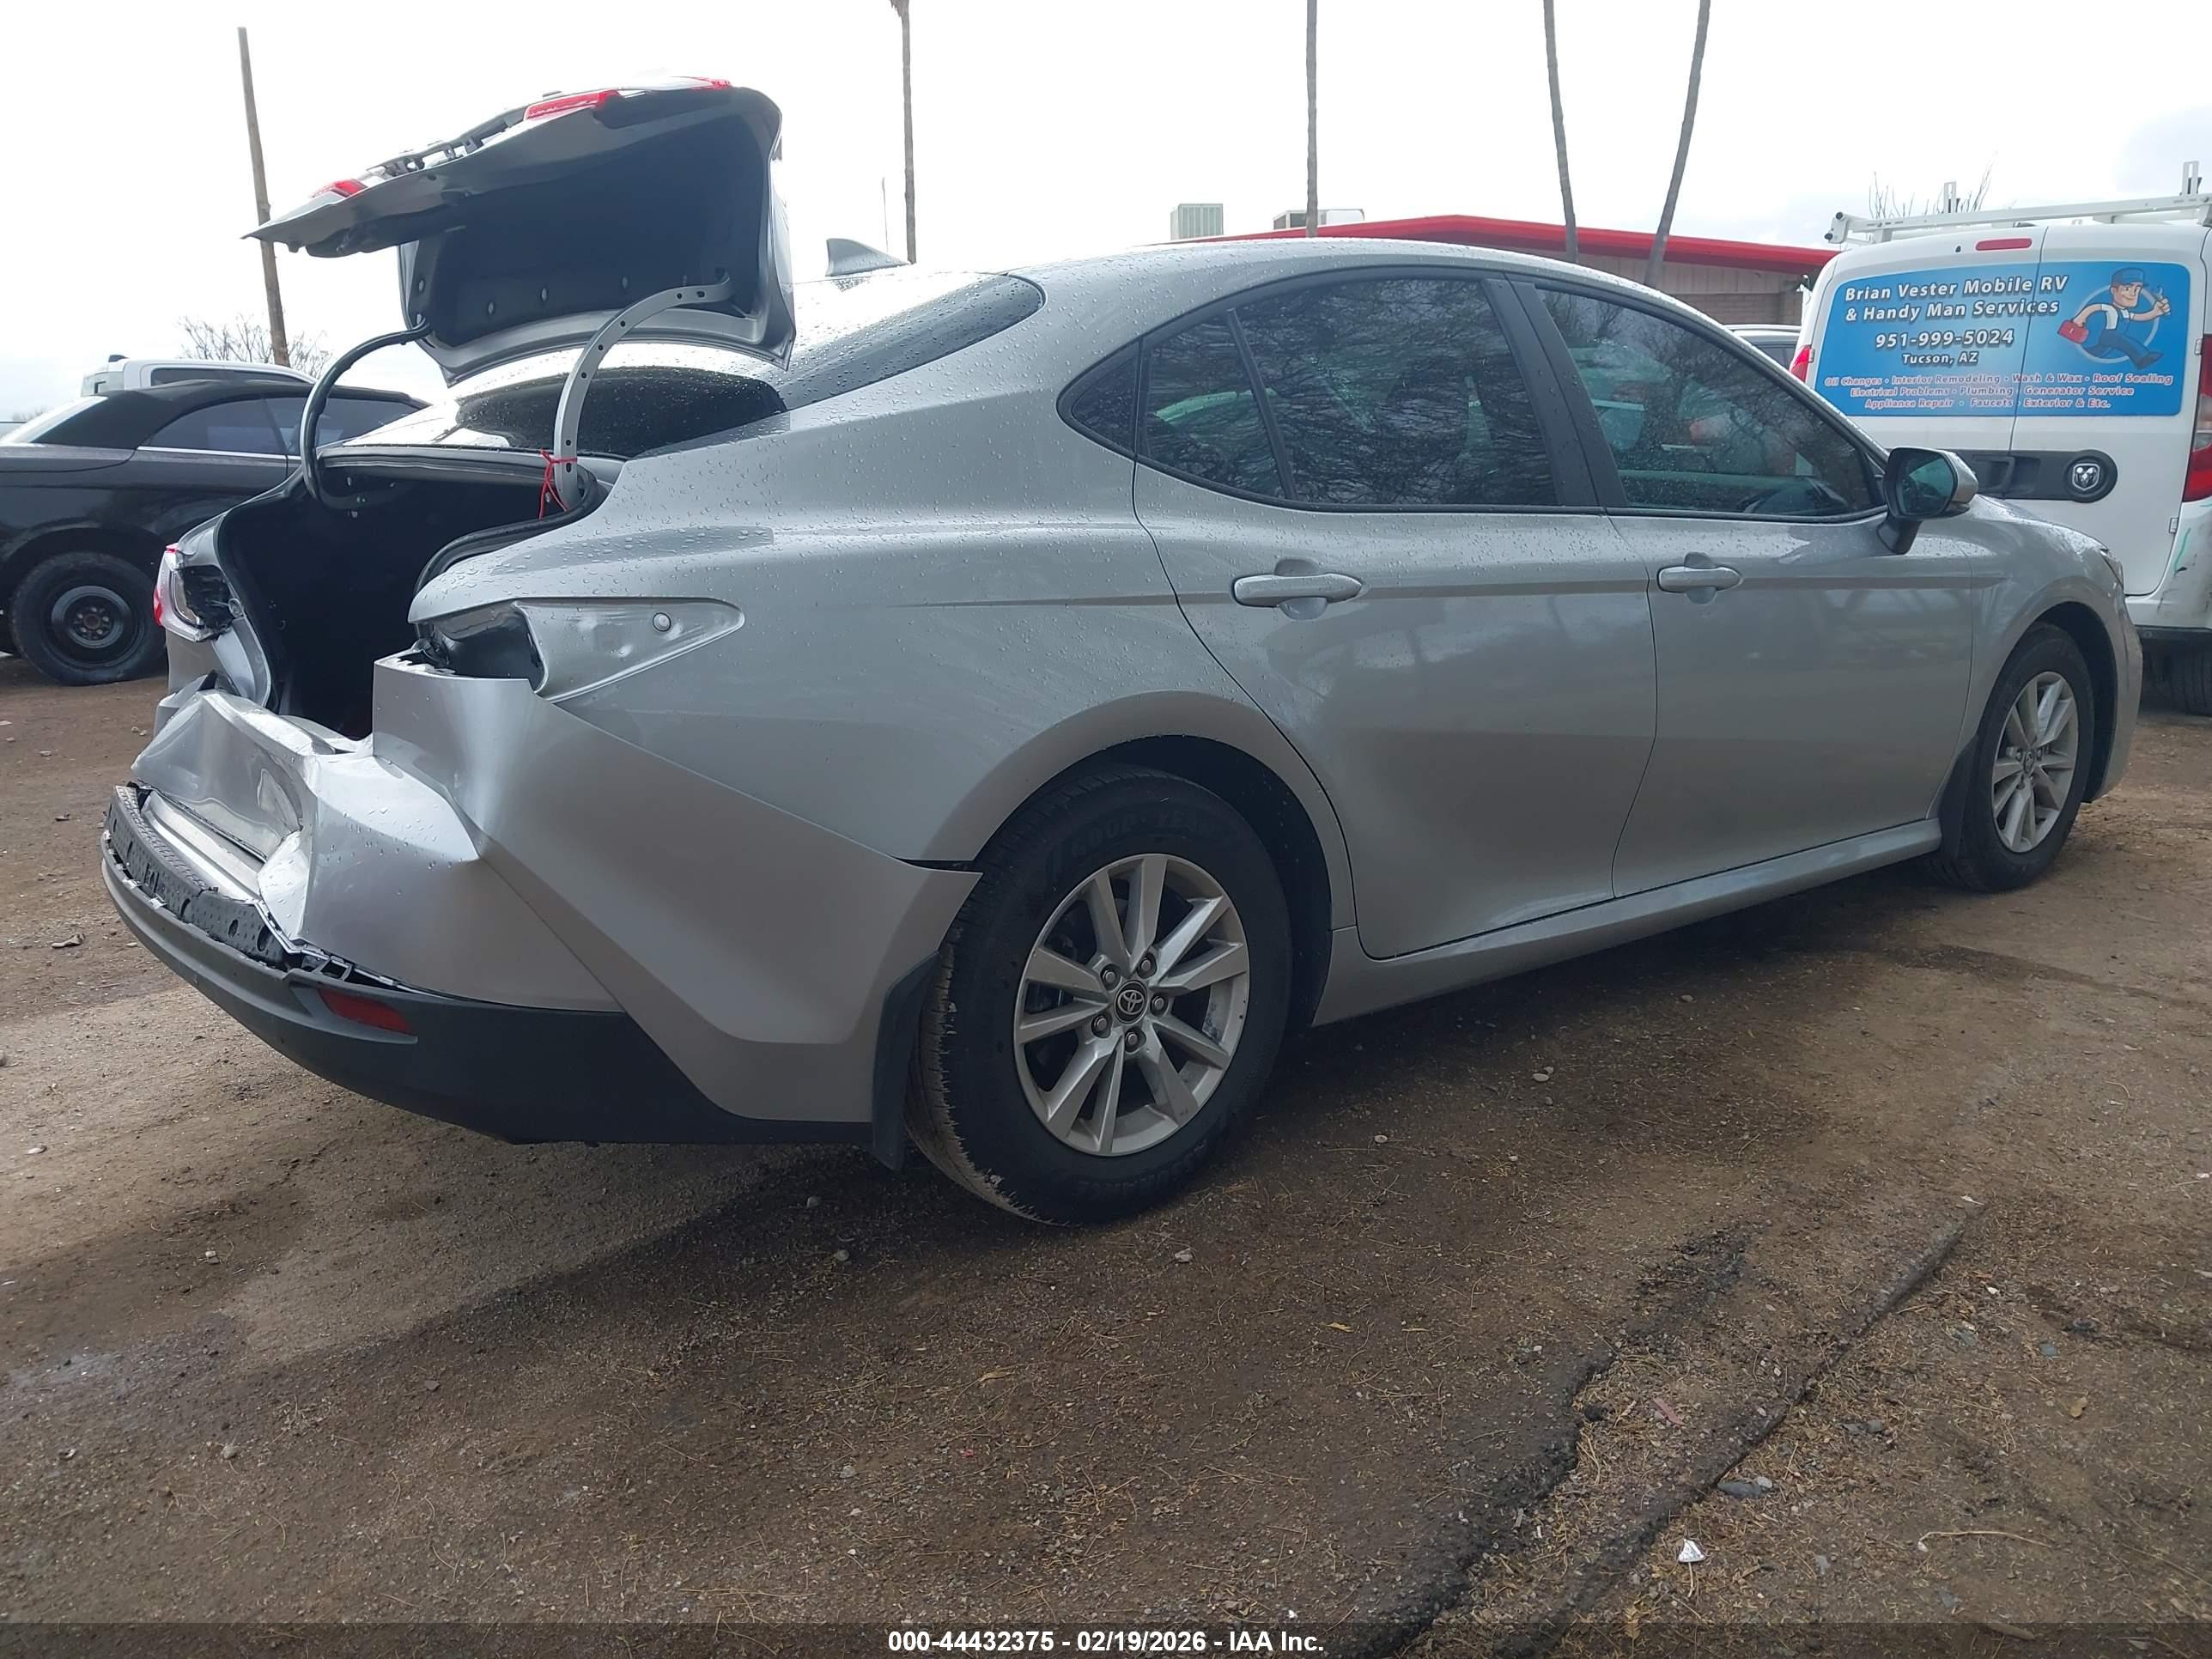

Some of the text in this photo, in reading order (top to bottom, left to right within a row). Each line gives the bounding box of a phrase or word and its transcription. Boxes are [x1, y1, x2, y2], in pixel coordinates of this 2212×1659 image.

[1844, 275, 2069, 301] Brian Vester Mobile RV
[1845, 298, 2059, 322] & Handy Man Services
[1875, 329, 2014, 349] 951-999-5024
[1902, 351, 1978, 365] Tucson, AZ
[1841, 376, 1883, 387] Changes
[1892, 374, 1932, 386] Interior
[1936, 373, 2001, 385] Remodeling
[2012, 373, 2042, 383] Wash
[2045, 373, 2054, 383] &
[2057, 373, 2082, 383] Wax
[2093, 373, 2122, 383] Roof
[2124, 373, 2174, 386] Sealing
[1850, 386, 2135, 397] Electrical Problems Plumbing Generator Service
[1865, 398, 2112, 410] Appliance Repair Faucets Exterior & Etc.
